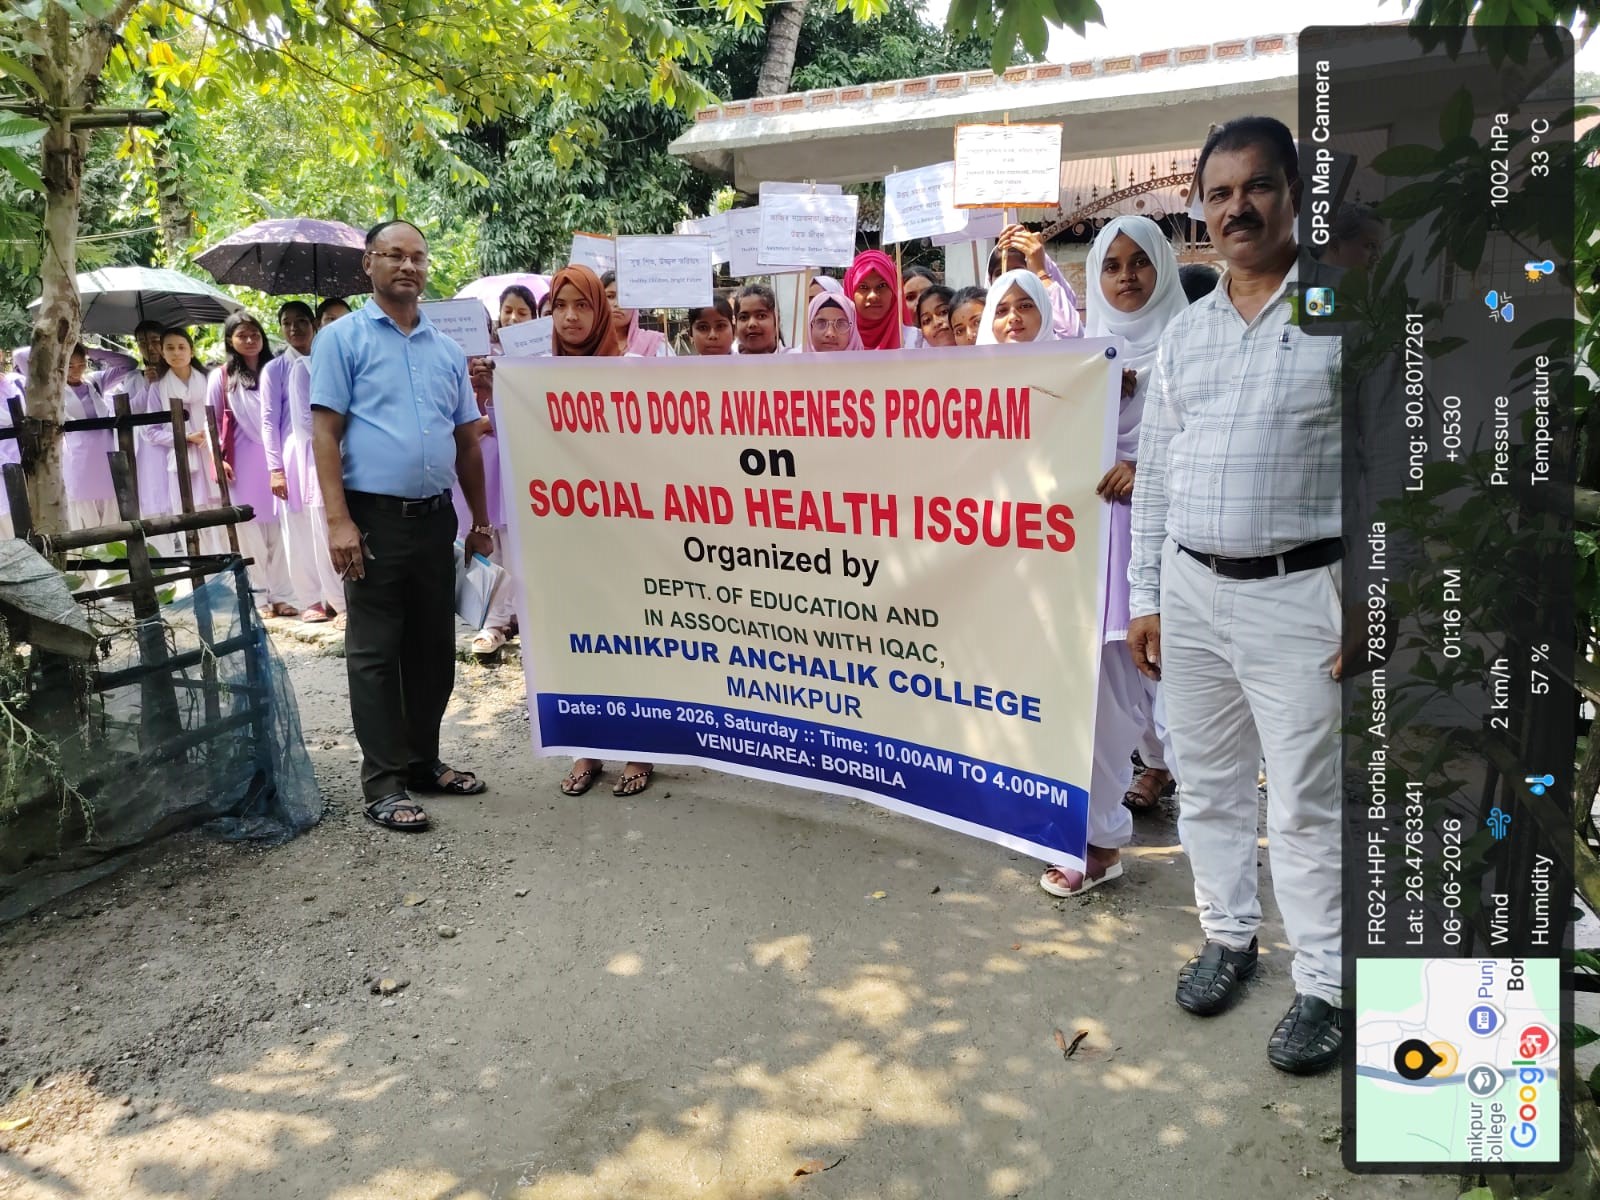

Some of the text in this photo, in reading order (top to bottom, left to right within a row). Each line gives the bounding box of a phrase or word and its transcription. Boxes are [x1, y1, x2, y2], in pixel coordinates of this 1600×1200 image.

[547, 386, 1031, 440] DOOR TO DOOR AWARENESS PROGRAM
[739, 446, 796, 478] on
[530, 479, 1076, 553] SOCIAL AND HEALTH ISSUES
[683, 536, 880, 587] Organized by
[643, 577, 940, 629] DEPTT. OF EDUCATION AND
[643, 608, 946, 669] IN ASSOCIATION WITH IQAC,
[569, 632, 1042, 724] MANIKPUR ANCHALIK COLLEGE
[726, 675, 863, 719] MANIKPUR
[557, 699, 602, 717] Date:
[606, 701, 627, 718] 06
[630, 702, 672, 721] June
[676, 706, 720, 728] 2026,
[723, 712, 799, 743] Saturday
[819, 729, 870, 755] Time:
[874, 741, 953, 777] 10.00AM
[958, 759, 988, 784] TO
[992, 770, 1069, 809] 4.00PM
[695, 731, 907, 790] VENUE/AREA: BORBILA
